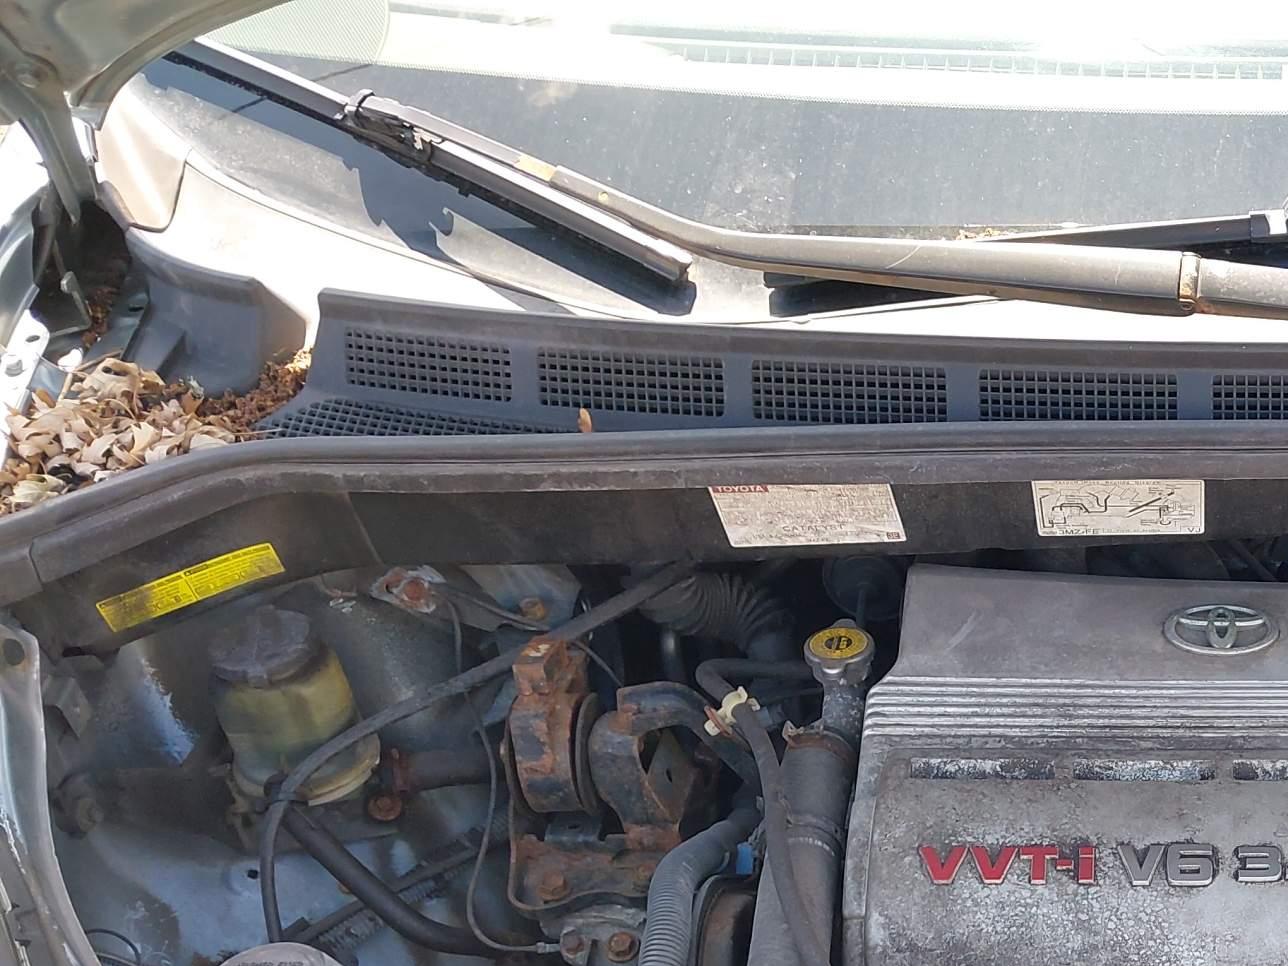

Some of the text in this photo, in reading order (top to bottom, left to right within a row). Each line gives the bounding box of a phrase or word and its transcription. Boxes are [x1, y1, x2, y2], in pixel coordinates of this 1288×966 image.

[716, 485, 764, 493] TOYOTA
[782, 523, 846, 532] CATALYST
[918, 844, 1097, 885] VVT-i
[1117, 843, 1217, 887] V6
